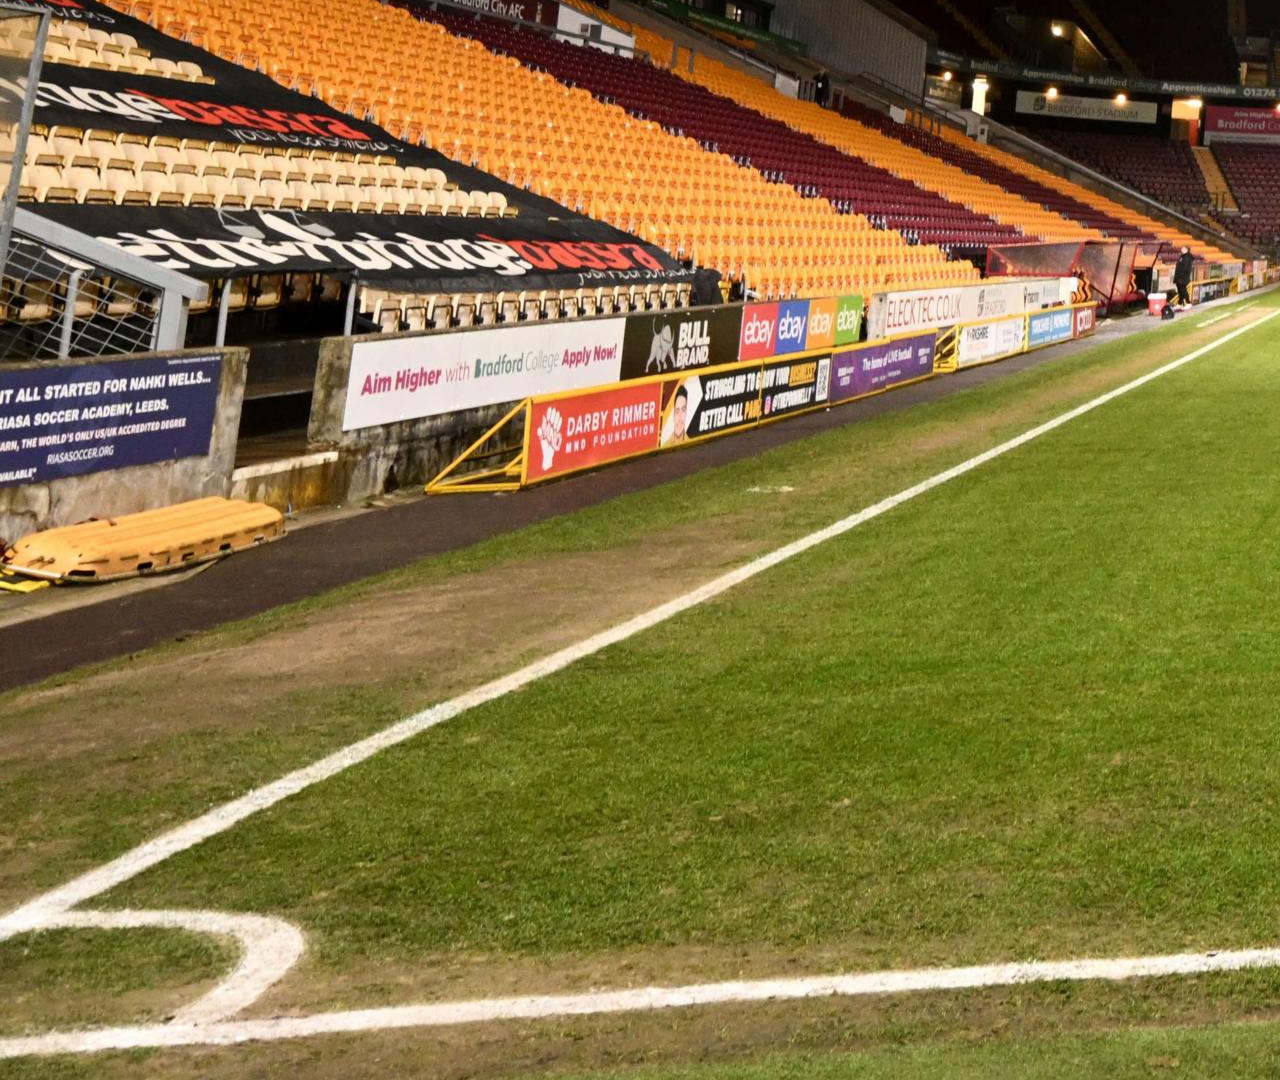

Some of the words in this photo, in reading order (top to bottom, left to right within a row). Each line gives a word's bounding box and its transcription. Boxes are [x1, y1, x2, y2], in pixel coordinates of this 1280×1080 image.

[508, 1, 525, 19] AFC
[1022, 69, 1084, 84] Apprenticeships
[1088, 75, 1127, 87] Bradford
[1161, 81, 1236, 95] Apprenticeships
[1243, 88, 1276, 98] 01274
[1047, 103, 1094, 116] BRADFORD
[1095, 106, 1138, 119] STADIUM
[1217, 119, 1266, 130] Bradford
[744, 312, 775, 349] ebay
[778, 309, 806, 343] ebay
[809, 308, 834, 338] ebay
[837, 304, 861, 335] ebay
[887, 294, 961, 329] ELECKTEC.CO.UK
[679, 320, 710, 348] BULL
[361, 374, 391, 396] Aim
[395, 367, 442, 392] Higher
[445, 361, 470, 382] with
[474, 352, 523, 379] Bradford
[525, 350, 560, 373] College
[561, 346, 592, 368] Apply
[593, 343, 617, 361] Now!
[863, 357, 871, 371] The
[871, 356, 882, 369] home
[888, 348, 898, 363] LIVE
[898, 346, 912, 360] football
[16, 388, 41, 403] ALL
[44, 382, 100, 400] STARTED
[103, 377, 127, 394] FOR
[130, 374, 166, 390] NAHKI
[168, 371, 211, 386] WELLS...
[705, 374, 746, 401] STRUGGLING
[747, 372, 756, 392] TO
[776, 366, 790, 386] YOUR
[790, 361, 816, 384] BUSINESS?
[34, 408, 79, 426] SOCCER
[81, 402, 133, 421] ACADEMY,
[135, 398, 169, 414] LEEDS.
[566, 412, 608, 436] DARBY
[612, 400, 656, 426] RIMMER
[699, 406, 726, 432] BETTER
[726, 402, 743, 425] CALL
[21, 437, 37, 448] THE
[38, 431, 74, 447] WORLD'S
[75, 429, 95, 442] ONLY
[95, 427, 118, 440] US/UK
[118, 421, 160, 436] ACCREDITED
[160, 418, 186, 431] DEGREE
[565, 440, 586, 454] MND
[593, 423, 655, 447] FOUNDATION
[46, 445, 115, 465] RIASASOCCER.ORG
